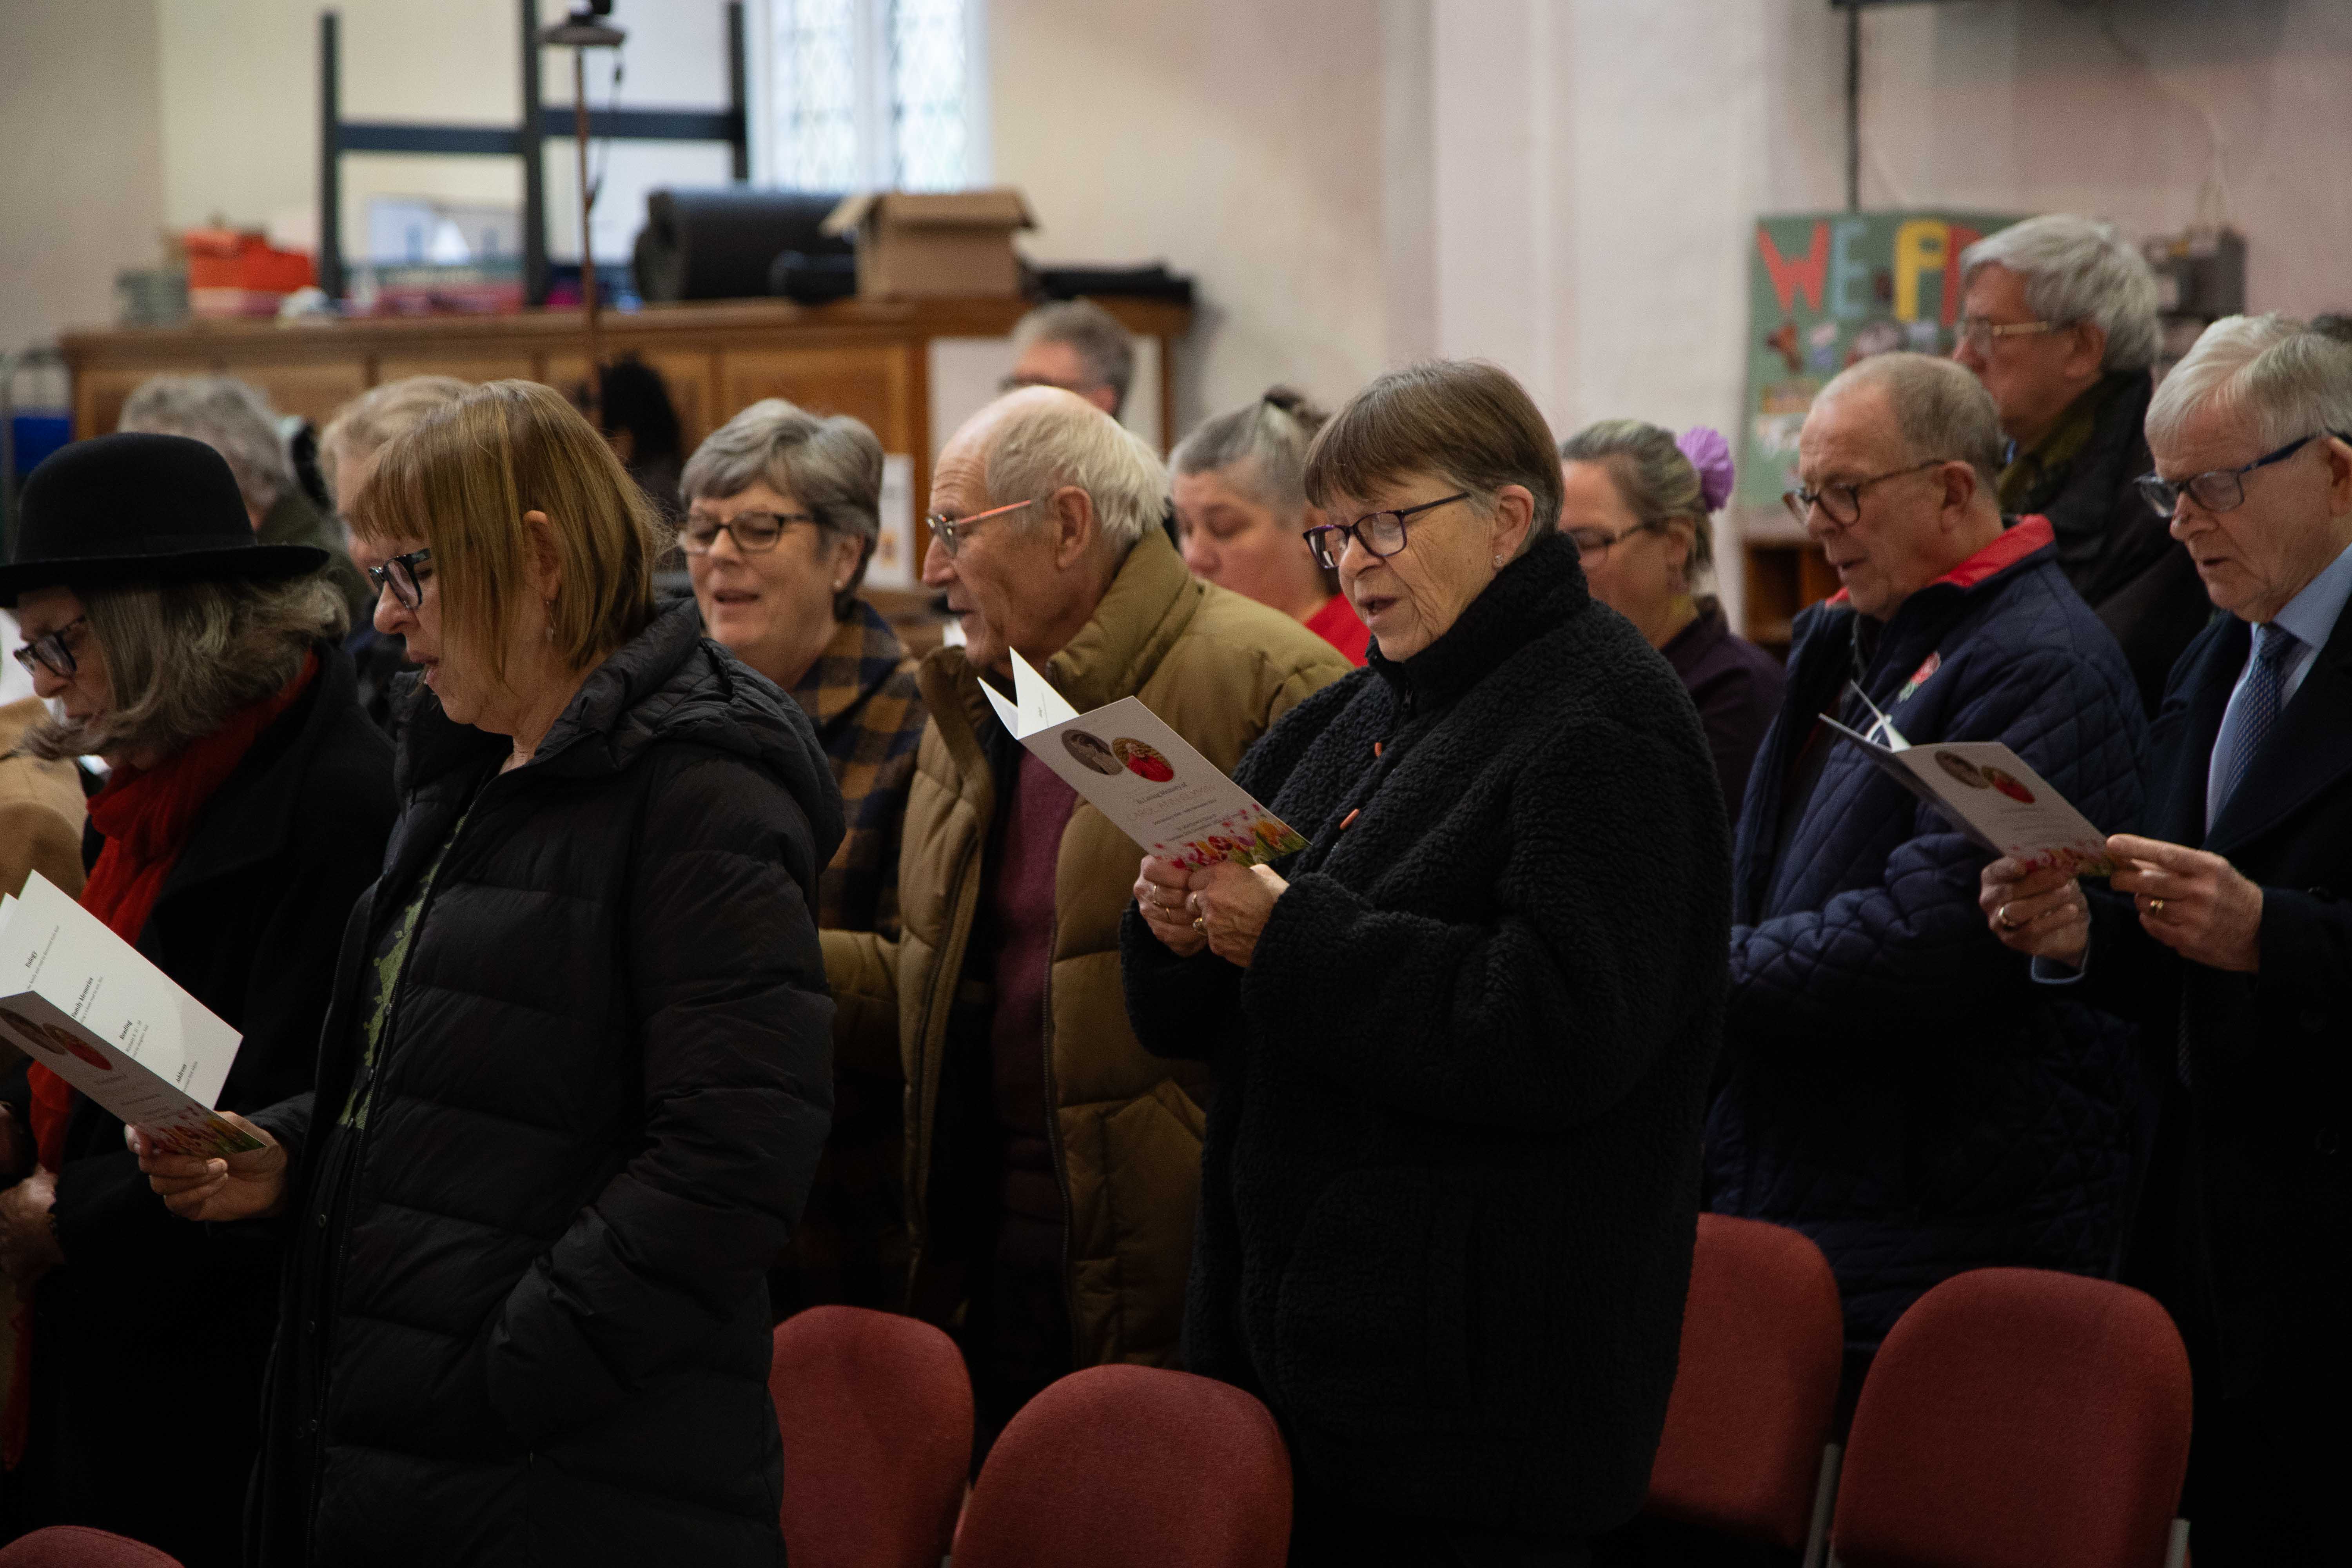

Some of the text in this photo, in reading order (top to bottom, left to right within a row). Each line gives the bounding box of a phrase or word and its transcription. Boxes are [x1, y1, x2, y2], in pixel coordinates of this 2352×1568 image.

[1142, 792, 1160, 803] Loving
[1160, 785, 1181, 796] Memory
[25, 950, 38, 968] Eulogy
[71, 1001, 83, 1018] Family
[78, 977, 94, 1001] Memories
[119, 1020, 133, 1040] Reading
[175, 1063, 188, 1083] Address
